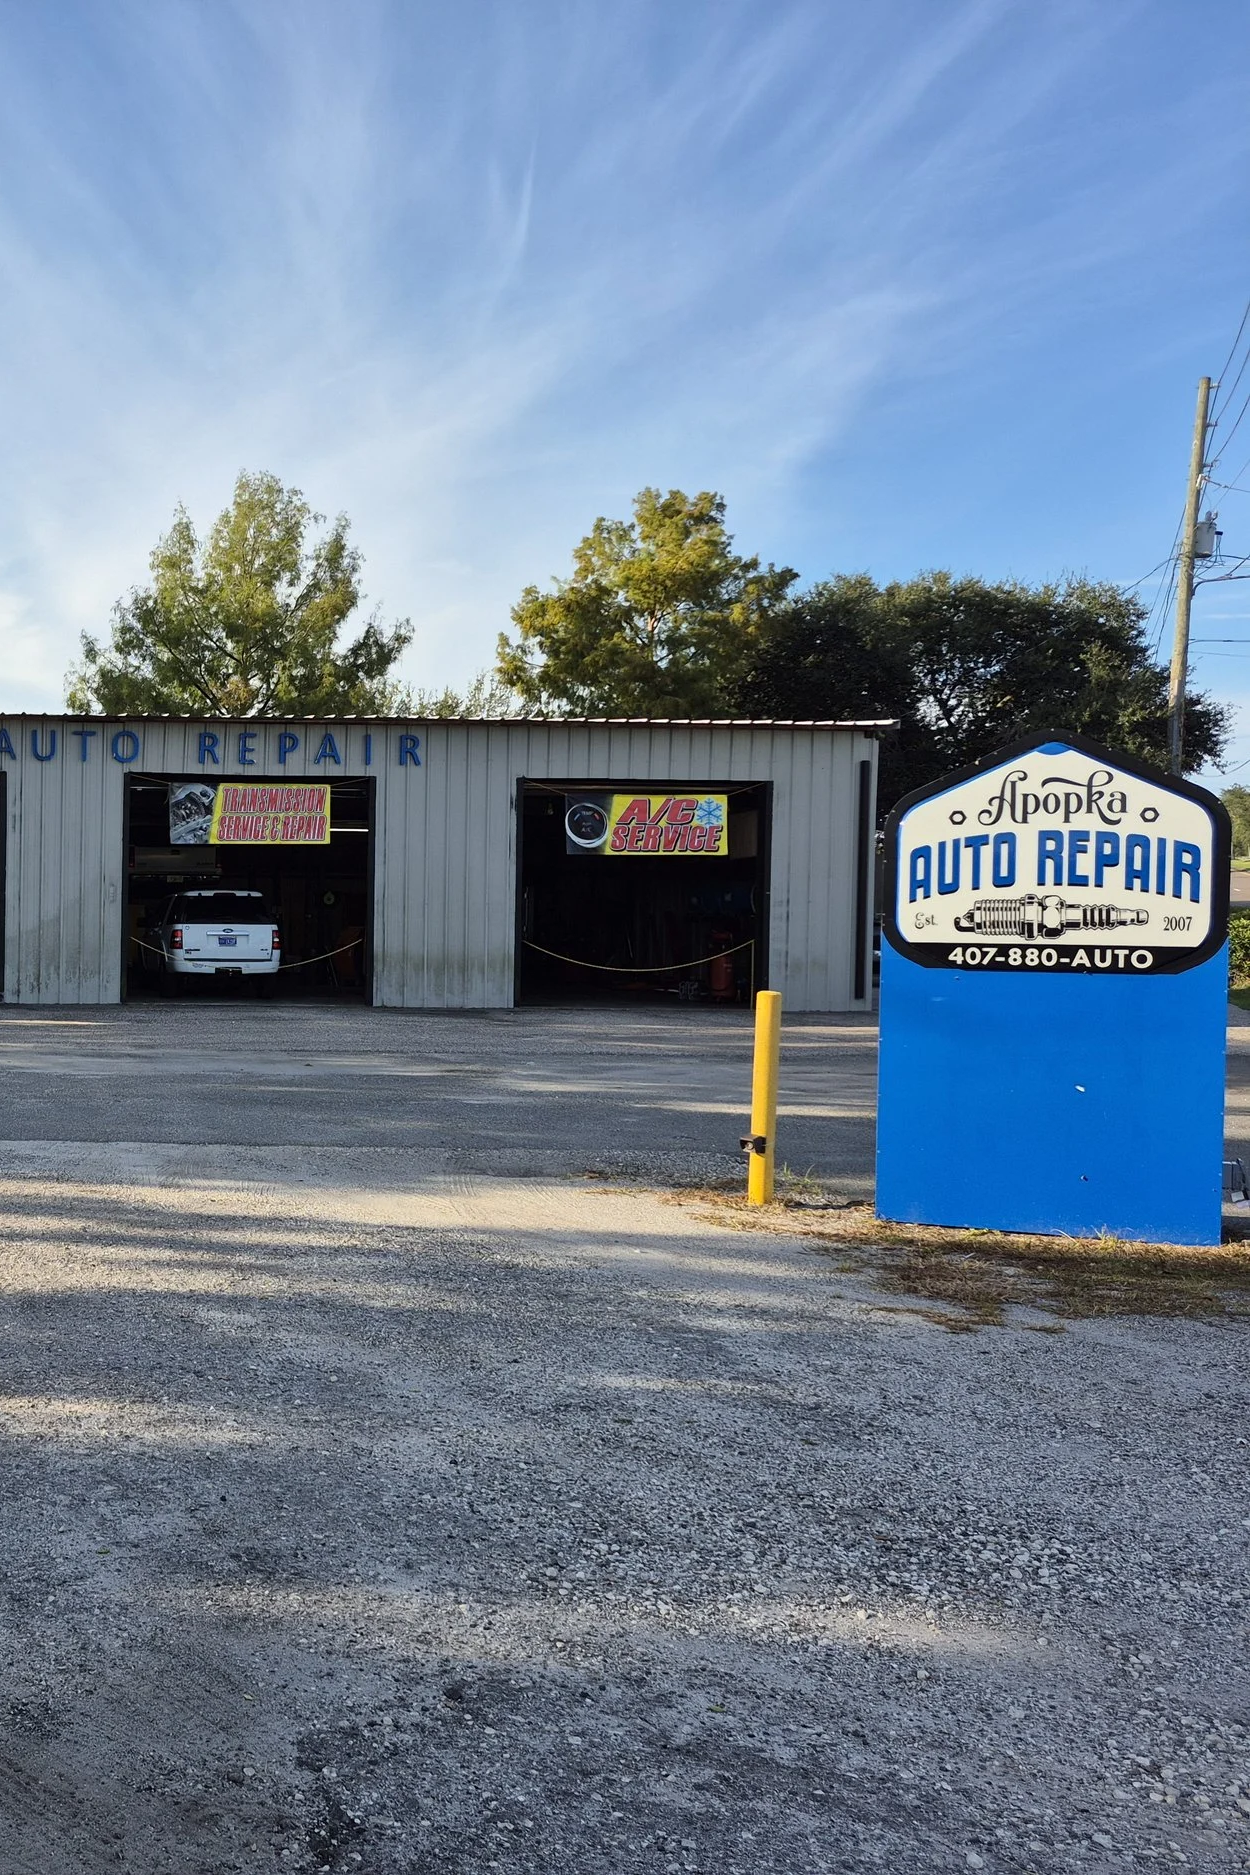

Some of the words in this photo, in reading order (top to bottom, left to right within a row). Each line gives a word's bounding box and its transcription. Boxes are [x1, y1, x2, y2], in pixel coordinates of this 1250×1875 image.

[198, 732, 422, 766] REPAIR
[222, 787, 327, 812] TRANSMISSION
[978, 769, 1129, 826] Apopka
[617, 798, 697, 825] A/C
[218, 815, 269, 840] SERVICE
[270, 815, 281, 841] &
[282, 815, 327, 841] REPAIR
[611, 825, 722, 851] SERVICE
[909, 831, 1017, 904] AUTO
[1037, 829, 1201, 904] REPAIR
[1163, 915, 1193, 933] 2007
[948, 947, 1154, 969] 407-880-AUTO
